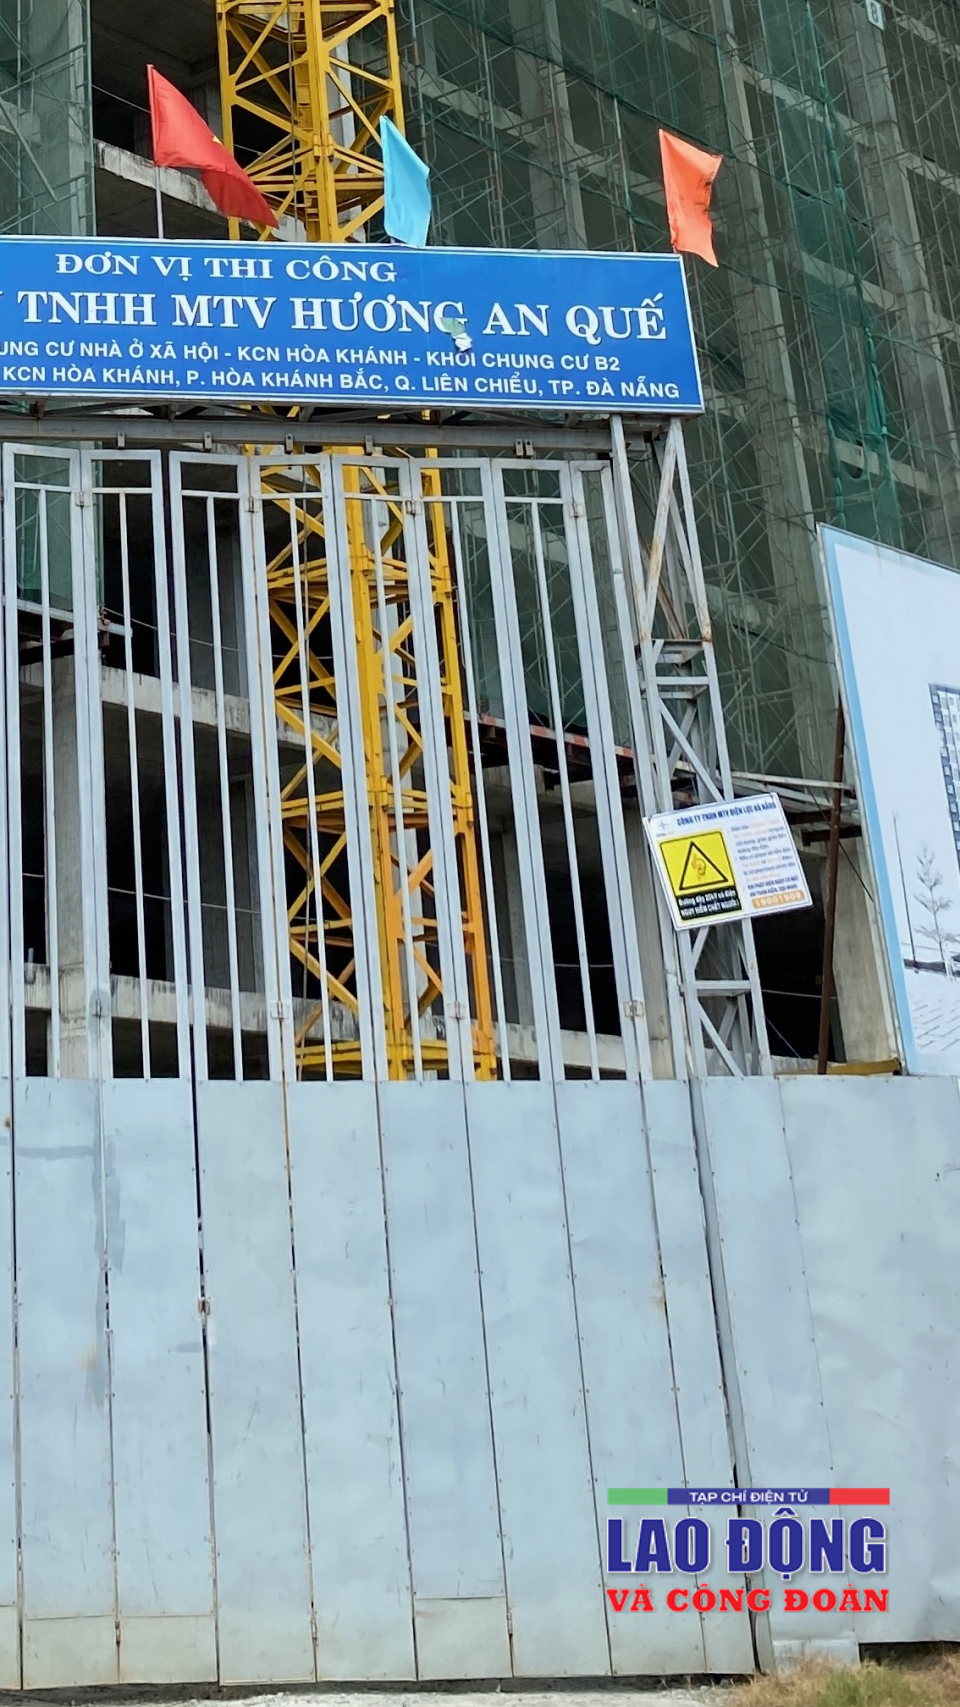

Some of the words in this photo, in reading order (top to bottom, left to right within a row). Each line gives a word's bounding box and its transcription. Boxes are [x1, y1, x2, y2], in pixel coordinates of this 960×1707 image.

[870, 2, 879, 24] 8
[55, 251, 140, 275] ĐƠN
[151, 256, 192, 282] VỊ
[203, 256, 275, 280] THI
[285, 254, 397, 282] CÔNG
[17, 290, 157, 326] TNHH
[170, 294, 277, 329] MTV
[289, 291, 469, 334] HƯƠNG
[482, 302, 550, 337] AN
[565, 292, 667, 346] QUẾ
[45, 339, 75, 357] CƯ
[79, 339, 123, 358] NHÀ
[128, 338, 144, 359] Ở
[150, 341, 177, 359] XÃ
[183, 341, 219, 363] HỘI
[237, 346, 280, 362] KCN
[286, 344, 330, 363] HÒA
[335, 345, 408, 365] KHÁNH
[481, 352, 556, 371] CHUNG
[560, 353, 590, 371] CƯ
[594, 355, 621, 371] B2
[3, 366, 46, 382] KCN
[52, 363, 97, 383] HÒA
[102, 365, 180, 388] KHÁNH,
[186, 370, 205, 385] P.
[211, 367, 256, 387] HÒA
[261, 369, 333, 389] KHÁNH
[339, 367, 389, 392] BẮC,
[394, 375, 416, 391] Q.
[421, 372, 469, 392] LIÊN
[473, 371, 544, 397] CHIỂU,
[548, 379, 580, 395] TP.
[585, 377, 615, 396] ĐÀ
[620, 375, 680, 399] NẴNG
